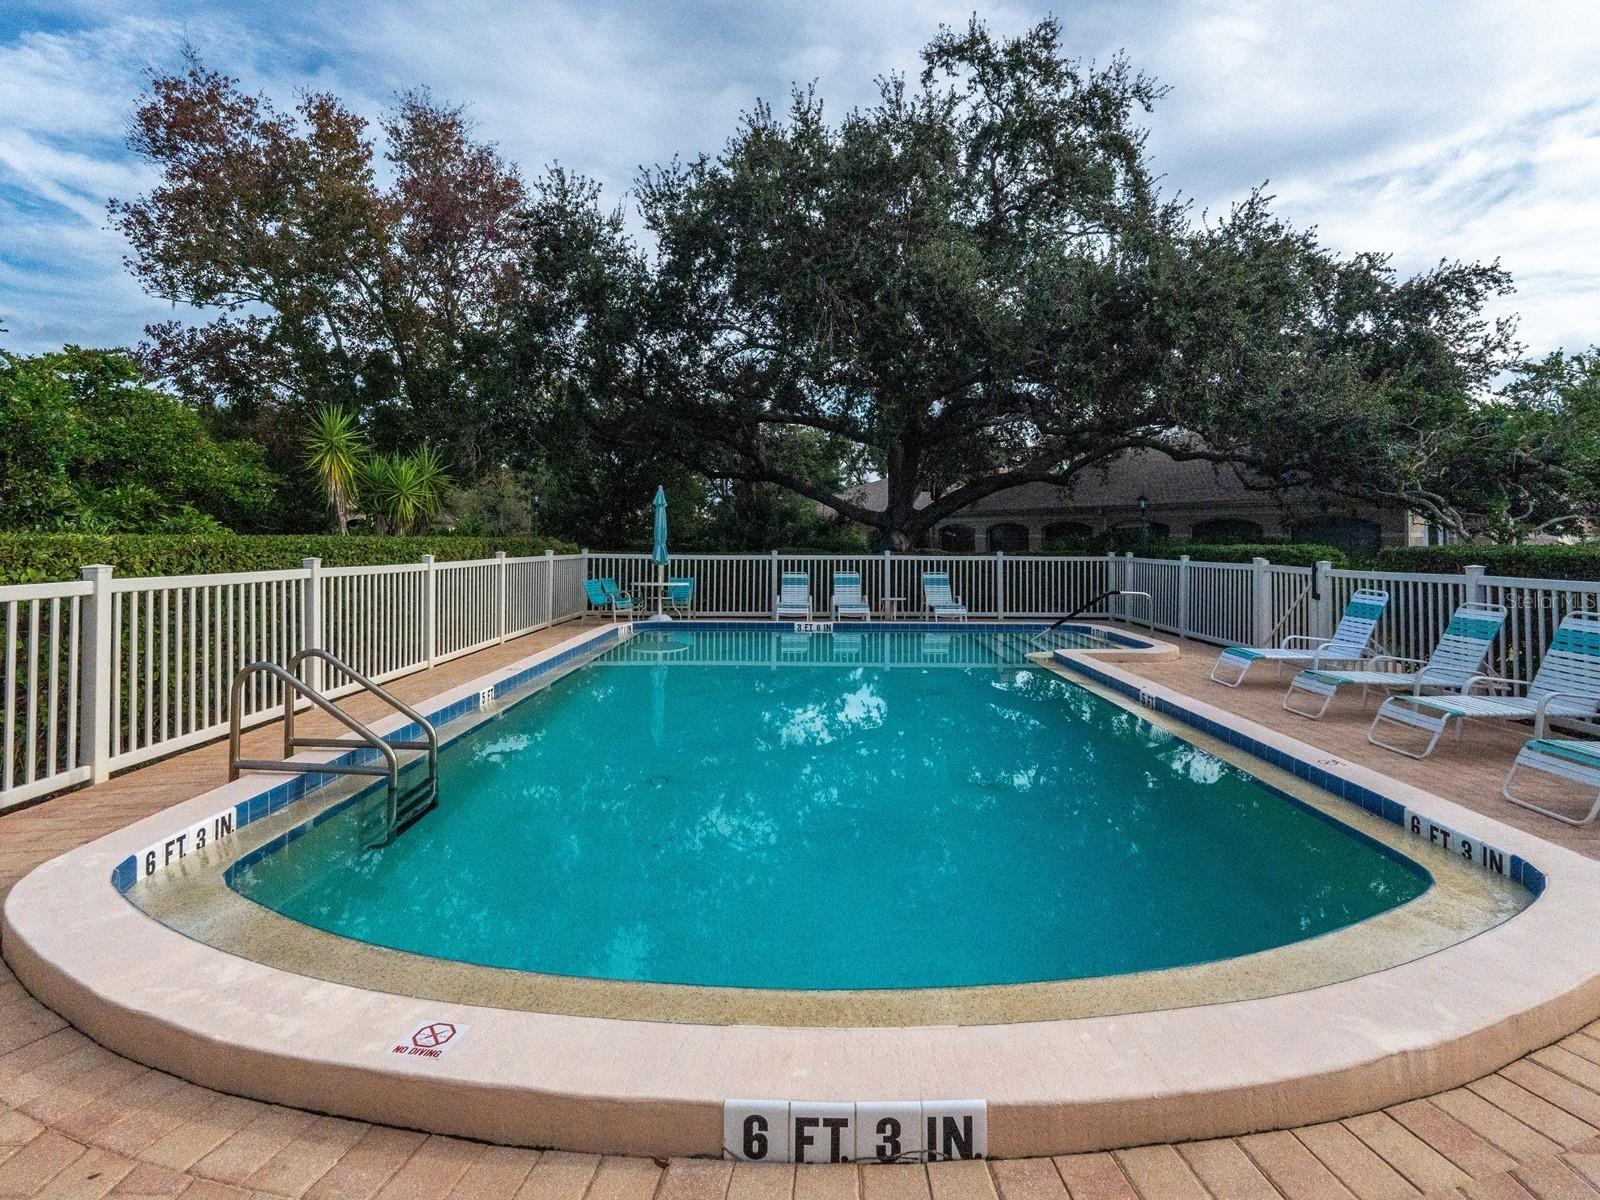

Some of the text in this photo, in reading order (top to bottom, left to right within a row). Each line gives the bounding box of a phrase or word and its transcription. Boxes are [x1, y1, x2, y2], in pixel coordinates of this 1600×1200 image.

[145, 850, 156, 876] 6
[196, 827, 206, 850] 3
[1411, 815, 1420, 834] 6
[1461, 840, 1472, 860] 3
[392, 1045, 442, 1058] NO DIVING
[743, 1115, 768, 1160] 6
[795, 1117, 849, 1163] FT.
[876, 1117, 901, 1163] 3
